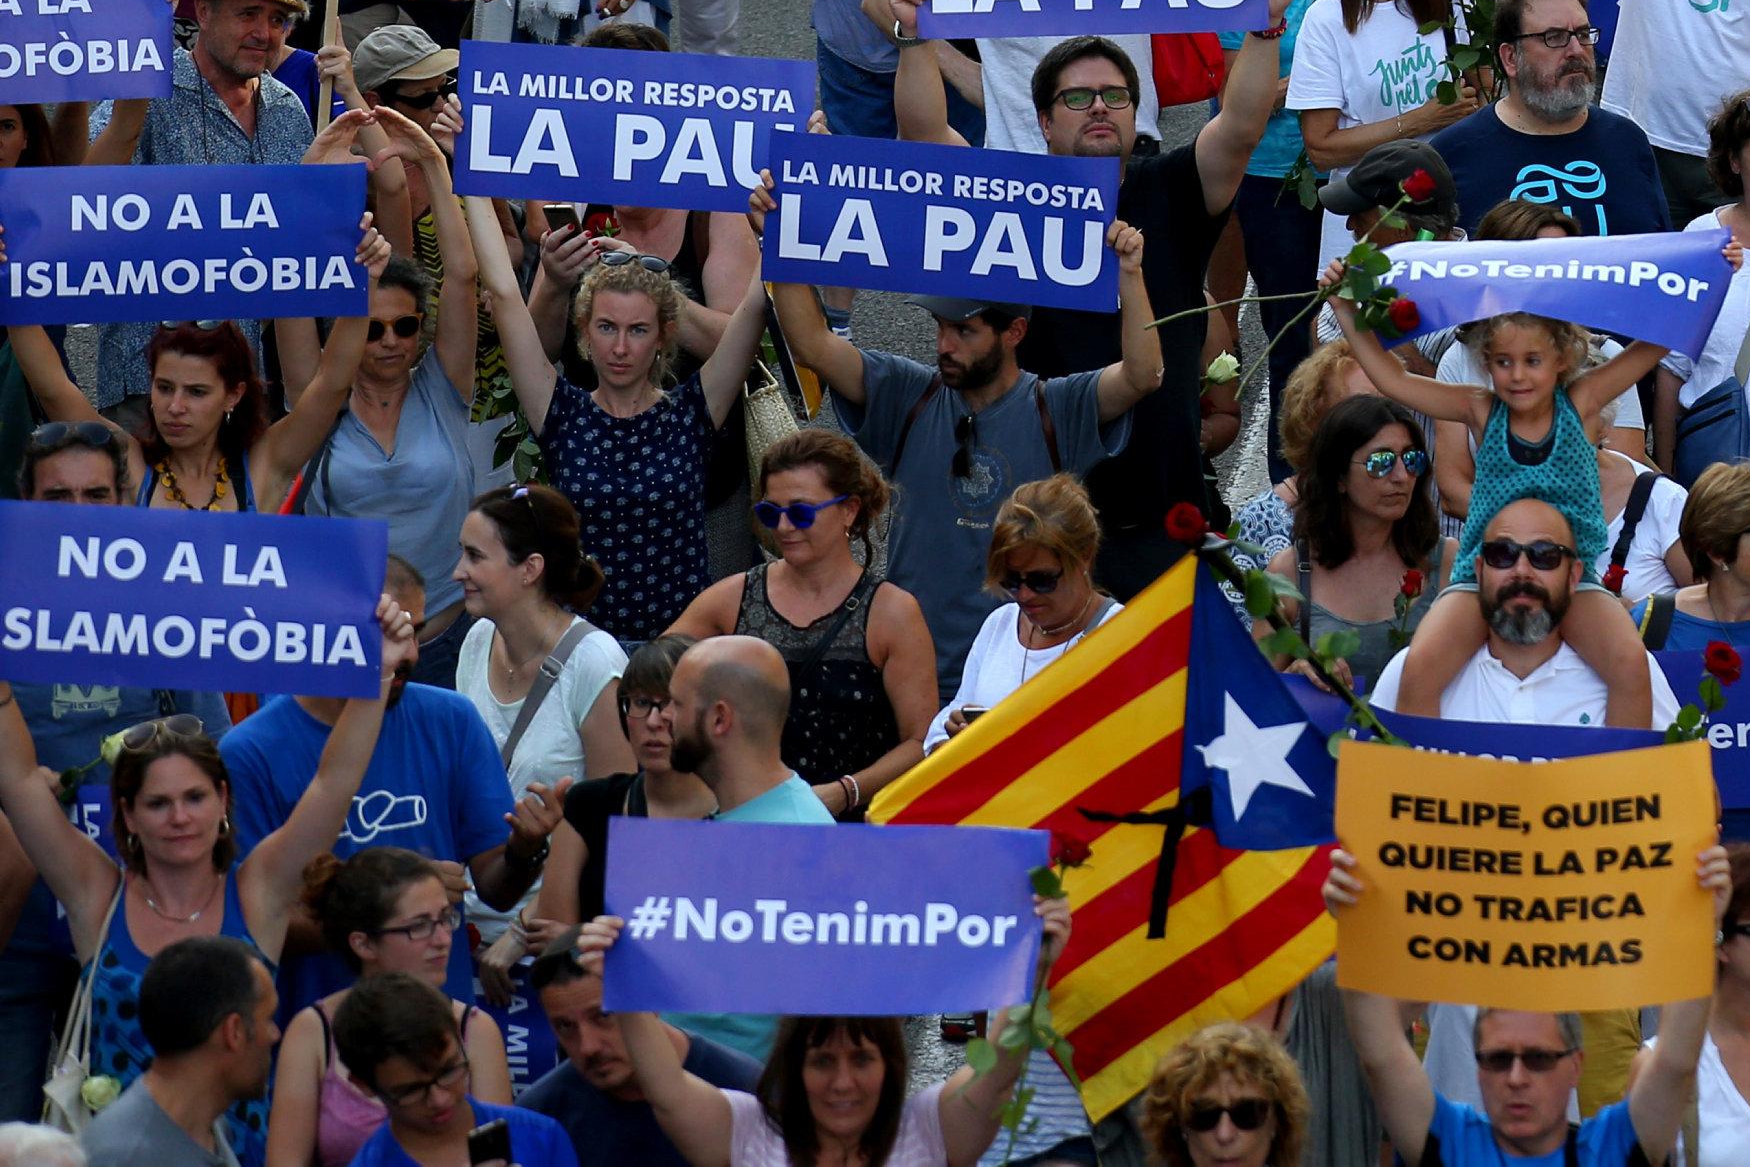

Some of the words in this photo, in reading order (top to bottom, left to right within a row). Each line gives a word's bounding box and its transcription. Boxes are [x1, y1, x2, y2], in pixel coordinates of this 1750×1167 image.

[474, 71, 510, 95] LA
[519, 74, 633, 103] MILLOR
[644, 82, 794, 113] RESPOSTA
[470, 105, 579, 177] LA
[72, 194, 150, 230] NO
[167, 194, 203, 229] A
[221, 193, 279, 228] LA
[11, 247, 354, 297] ISLAMOFÒBIA
[1378, 259, 1709, 303] #NoTenimPor
[58, 536, 146, 580] NO
[163, 542, 203, 583] A
[223, 545, 287, 587] LA
[1391, 794, 1530, 835] FELIPE,
[1545, 794, 1660, 830] QUIEN
[1379, 842, 1522, 875] QUIERE
[1534, 851, 1584, 875] LA
[1596, 842, 1672, 873] PAZ
[628, 897, 1017, 946] #NoTenimPor
[1406, 891, 1462, 917] NO
[1474, 893, 1645, 922] TRAFICA
[1407, 935, 1490, 964] CON
[1501, 940, 1642, 968] ARMAS
